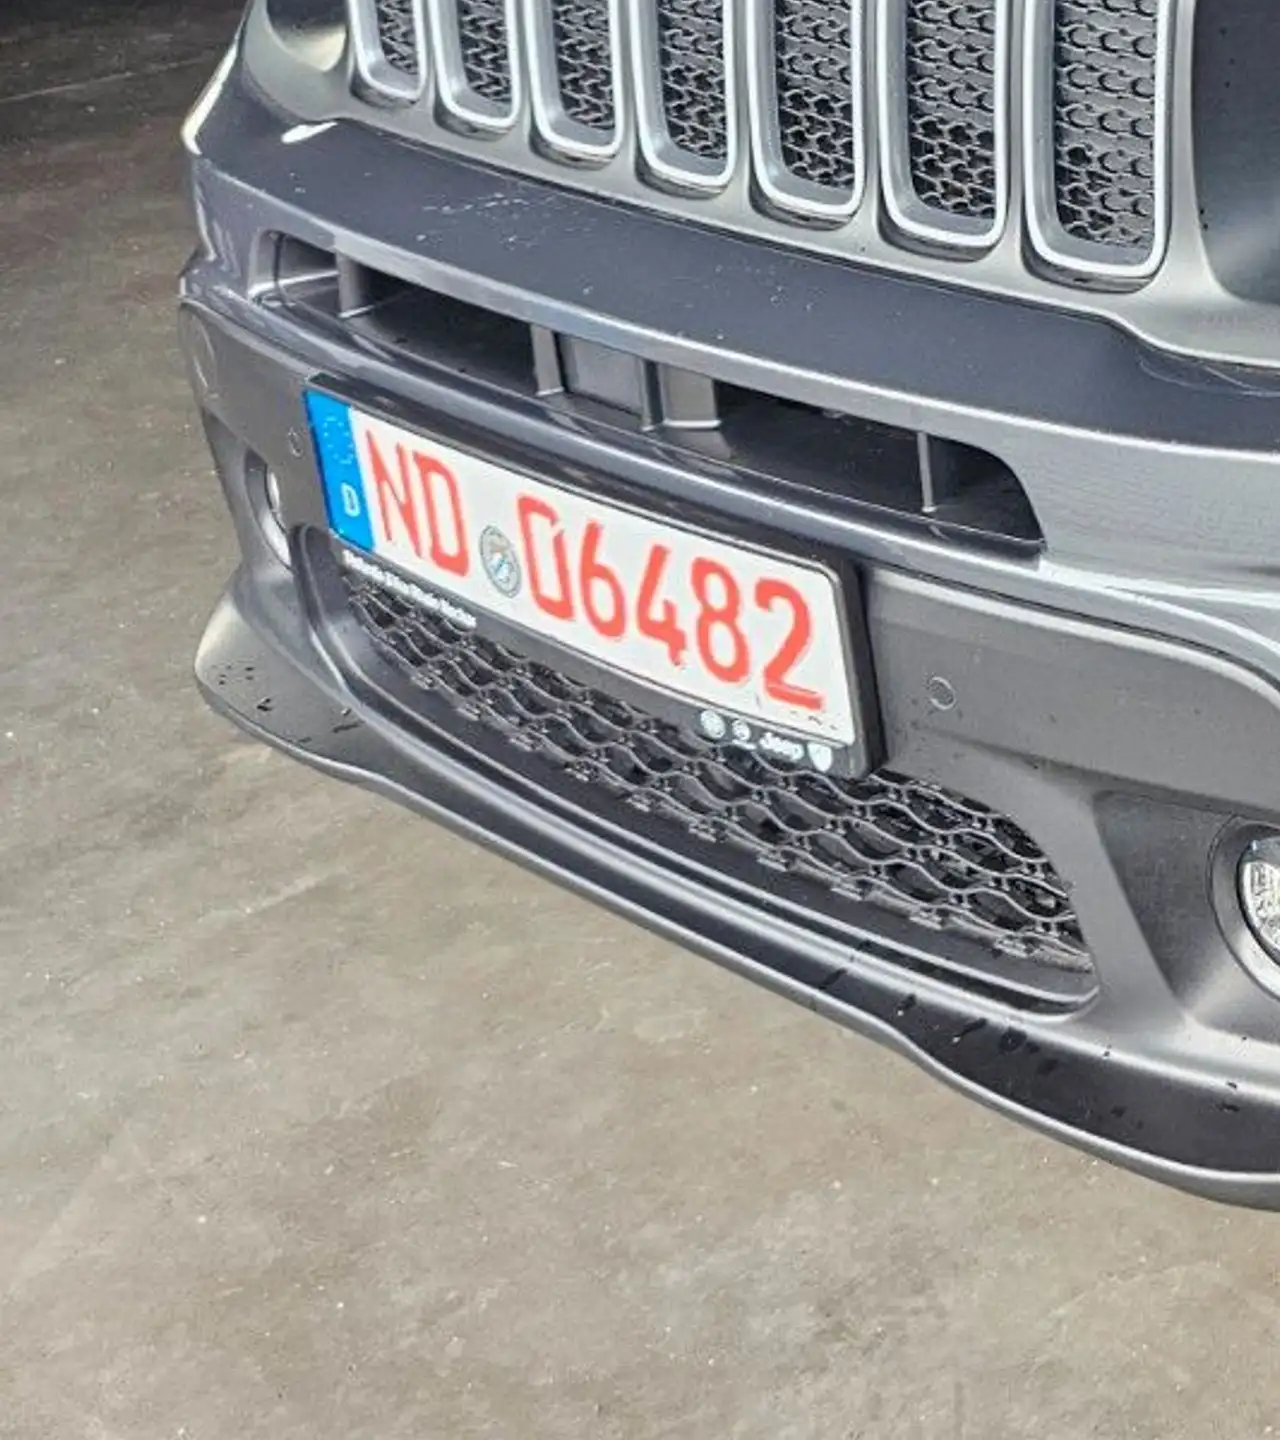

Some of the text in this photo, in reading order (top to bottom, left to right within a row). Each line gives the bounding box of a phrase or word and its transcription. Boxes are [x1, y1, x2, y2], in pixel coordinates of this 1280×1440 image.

[340, 481, 361, 517] D
[365, 428, 469, 577] ND
[517, 494, 824, 711] 06482
